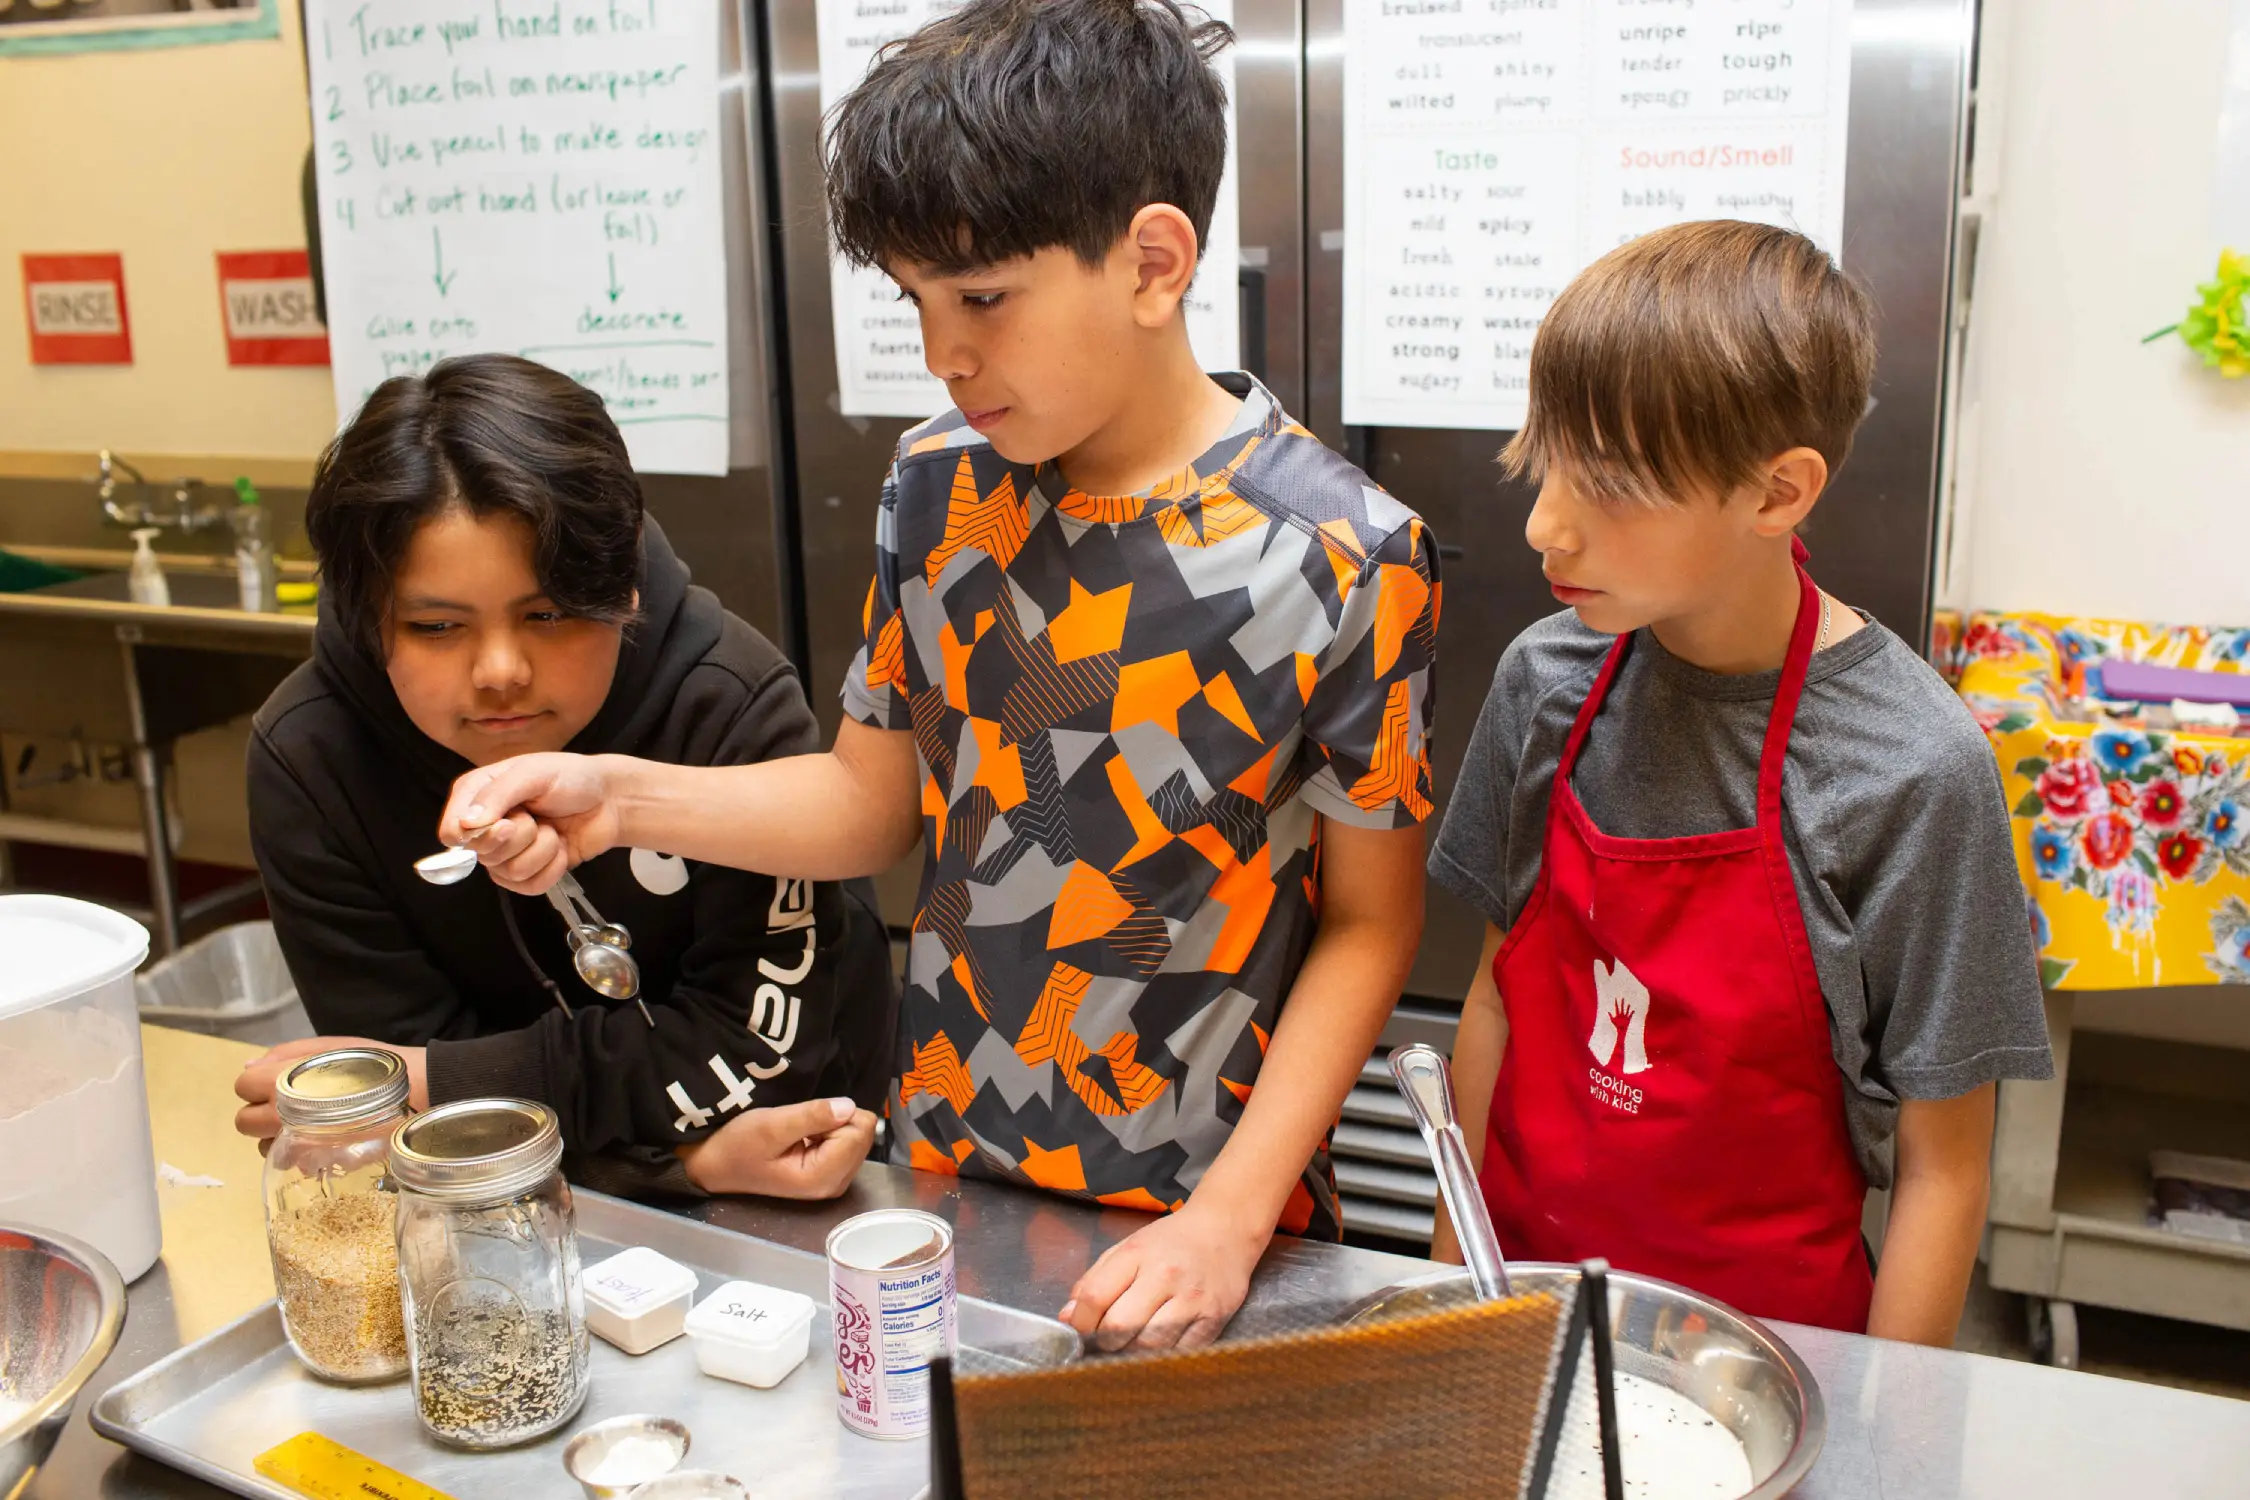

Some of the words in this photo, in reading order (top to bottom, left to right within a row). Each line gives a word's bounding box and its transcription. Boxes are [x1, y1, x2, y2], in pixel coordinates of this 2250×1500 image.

[349, 3, 424, 57] Trace
[437, 17, 480, 55] your
[1619, 25, 1687, 43] unripe
[1735, 18, 1783, 40] ripe
[1620, 53, 1684, 72] tender
[1721, 50, 1793, 71] tough
[326, 85, 345, 121] 2
[364, 69, 443, 109] Place
[452, 66, 497, 101] foil
[509, 75, 537, 97] on
[546, 63, 687, 101] newspaper
[1388, 92, 1456, 110] wilted
[1723, 83, 1793, 105] prickly
[330, 139, 354, 174] 3
[1434, 149, 1500, 171] Taste
[1619, 144, 1794, 170] Sound/Smell
[1403, 184, 1463, 202] salty
[1478, 216, 1532, 236] spicy
[35, 293, 117, 327] RINSE
[1385, 315, 1463, 332] creamy
[1391, 343, 1461, 361] strong
[1588, 1067, 1643, 1104] cooking
[1590, 1084, 1609, 1104] with
[1611, 1095, 1639, 1114] kids
[879, 1278, 920, 1292] Nutrition
[921, 1270, 941, 1285] Facts
[719, 1302, 768, 1323] Salt
[882, 1321, 914, 1330] Calories
[937, 1306, 943, 1316] 0
